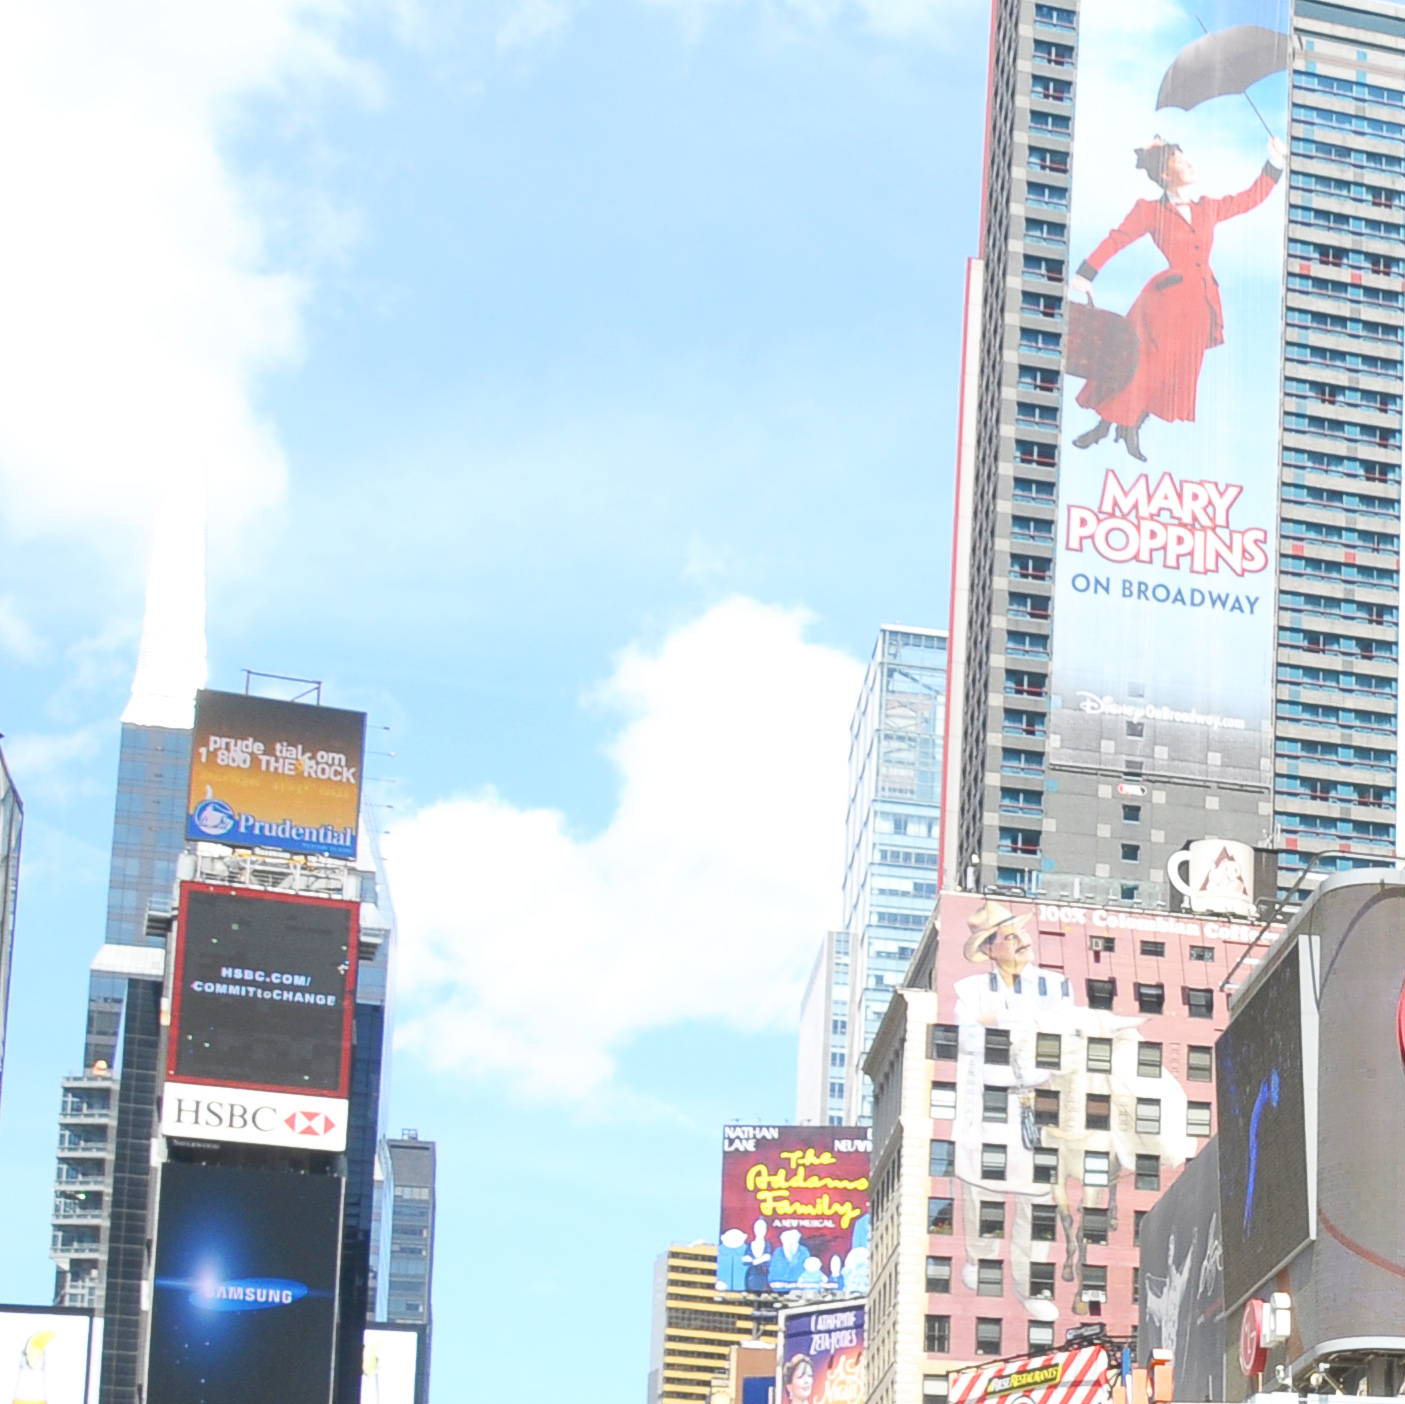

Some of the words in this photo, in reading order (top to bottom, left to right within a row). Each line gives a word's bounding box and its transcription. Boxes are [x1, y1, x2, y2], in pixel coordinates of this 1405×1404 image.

[1098, 468, 1243, 528] MARY
[1066, 504, 1268, 577] POPPINS
[1071, 573, 1110, 595] ON
[1122, 578, 1260, 615] BROADWAY
[217, 751, 250, 769] 800
[258, 755, 296, 775] THE
[303, 760, 357, 784] ROCK
[238, 813, 354, 846] Prudential
[1039, 905, 1087, 924] 100%
[1093, 909, 1201, 936] Colombian
[221, 966, 312, 987] HSBC.COM/
[191, 980, 336, 1006] COMMITtoCHANGE
[175, 1097, 277, 1132] HSBC
[724, 1127, 779, 1139] NATHAN
[724, 1139, 757, 1151] LANE
[780, 1148, 837, 1169] The
[746, 1163, 869, 1191] Addams
[756, 1189, 861, 1230] Family
